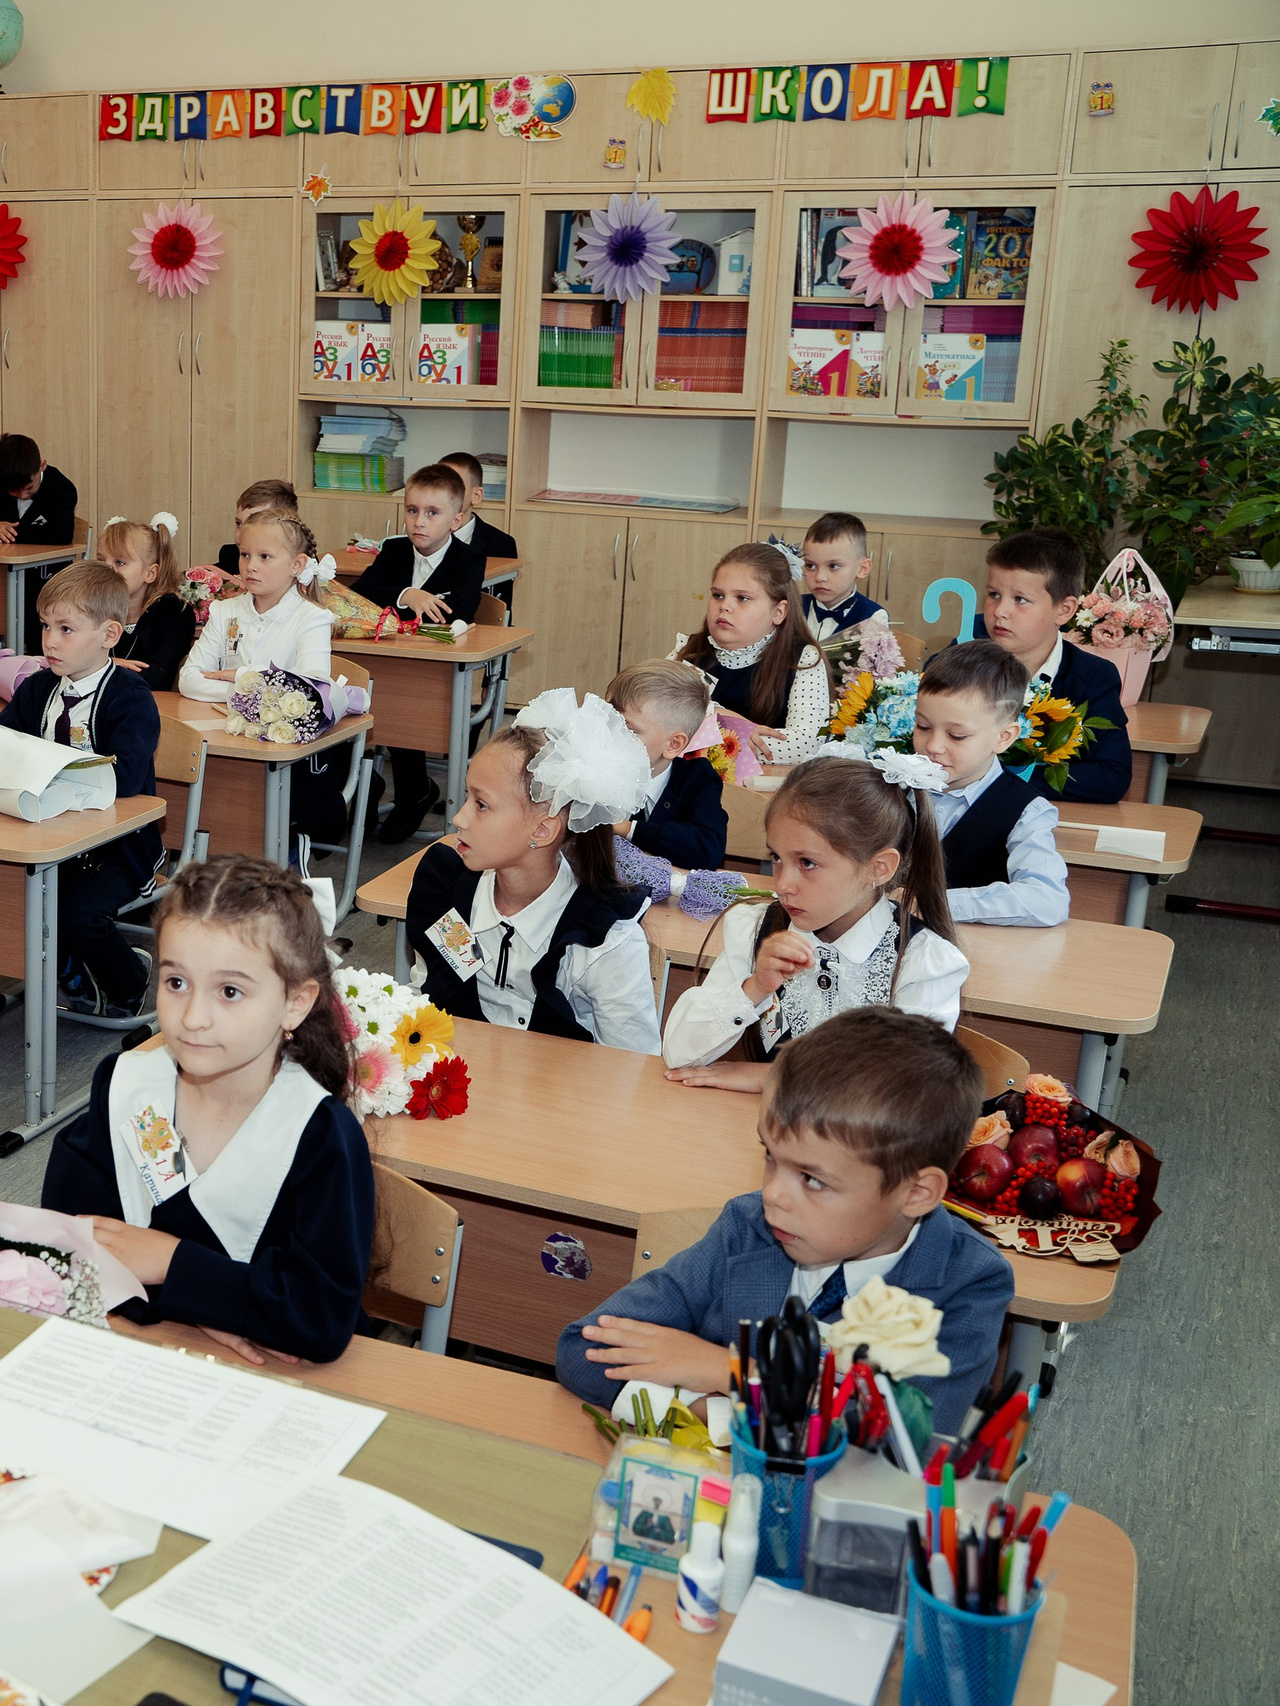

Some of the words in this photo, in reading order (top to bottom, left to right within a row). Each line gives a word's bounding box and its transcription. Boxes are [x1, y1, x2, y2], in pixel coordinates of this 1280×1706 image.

[707, 60, 990, 115] ШКОЛА!
[106, 83, 488, 134] ЗДРАВСТВУЙ,
[982, 258, 1031, 268] ФАКТО
[316, 331, 342, 340] Русский
[423, 334, 452, 343] Русский
[924, 351, 976, 360] Математика
[344, 362, 352, 380] 1
[454, 365, 461, 384] 1
[828, 372, 839, 396] 1
[963, 376, 975, 401] 1
[140, 1162, 164, 1205] Карина
